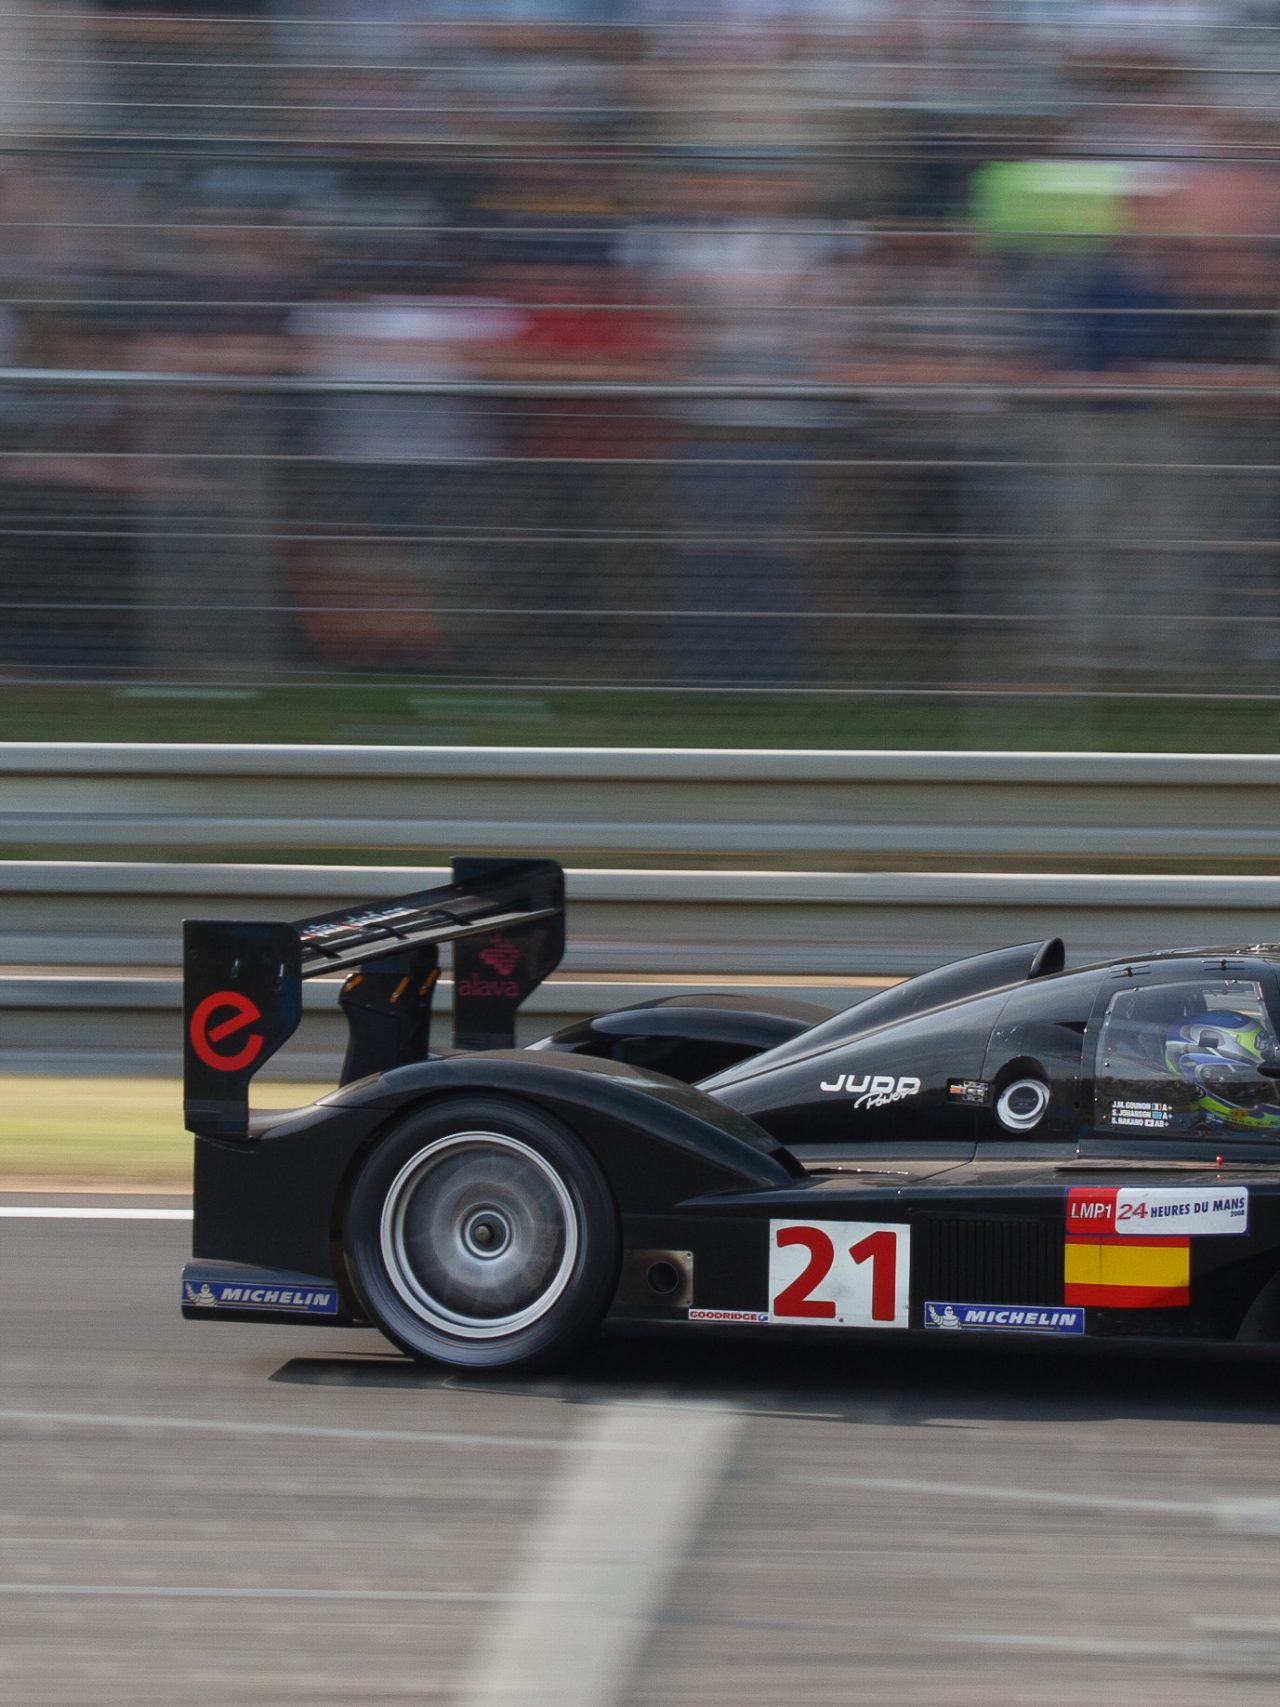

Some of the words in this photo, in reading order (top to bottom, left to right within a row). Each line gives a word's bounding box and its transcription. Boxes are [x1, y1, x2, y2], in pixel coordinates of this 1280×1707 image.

[190, 991, 264, 1072] e
[820, 1074, 921, 1095] JUDD
[1071, 1203, 1112, 1219] LMP1
[1117, 1202, 1149, 1220] 24
[1150, 1203, 1190, 1218] HEURES
[1194, 1201, 1209, 1213] DU
[1213, 1197, 1245, 1212] MANS
[773, 1226, 897, 1321] 21
[221, 1288, 331, 1306] MICHELIN
[690, 1311, 757, 1320] GOODRIDGE
[965, 1310, 1076, 1326] MICHELIN
